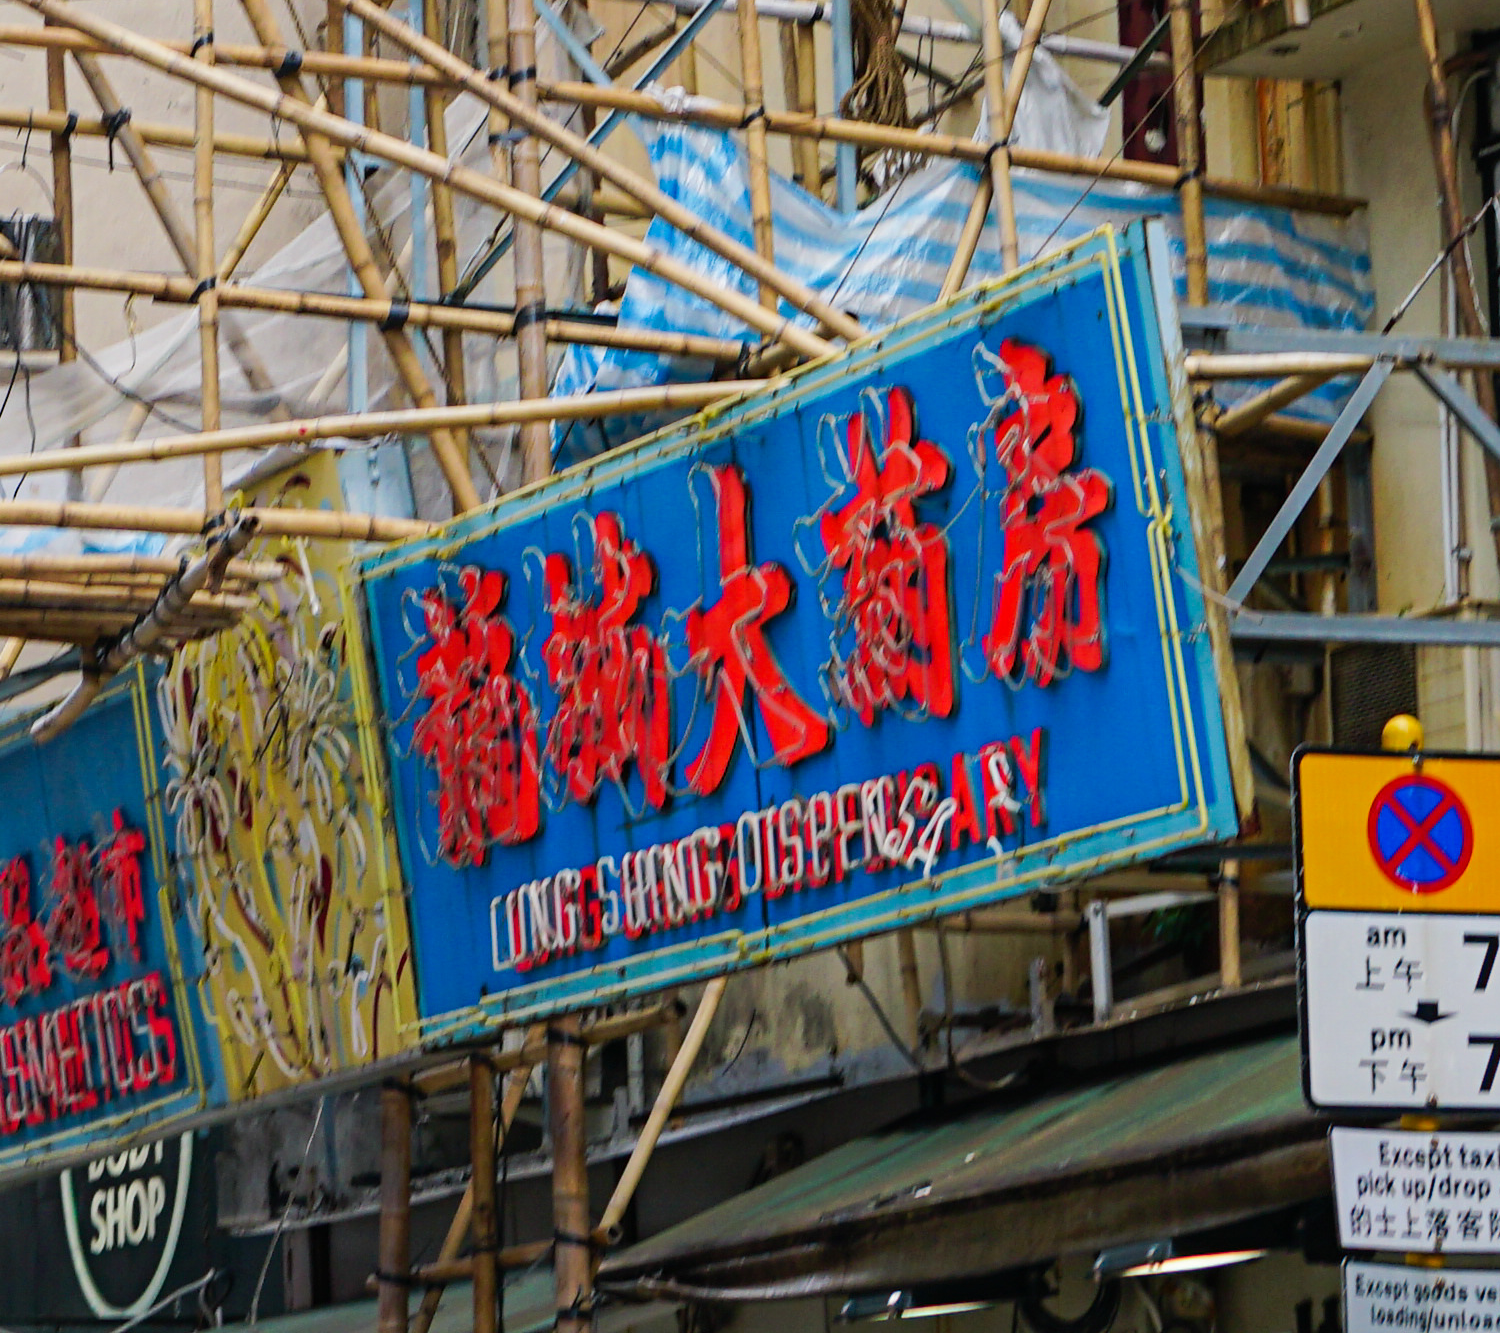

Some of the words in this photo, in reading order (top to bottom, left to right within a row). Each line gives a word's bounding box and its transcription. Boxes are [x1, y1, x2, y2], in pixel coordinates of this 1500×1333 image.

[1366, 923, 1406, 947] am
[1355, 957, 1423, 993] 上午
[1462, 935, 1500, 992] 7
[1370, 1028, 1411, 1054] pm
[1358, 1059, 1427, 1096] 下午
[1379, 1141, 1452, 1172] Except
[1357, 1170, 1395, 1199] pick
[1402, 1175, 1491, 1202] up/drop
[91, 1176, 166, 1254] SHOP
[1356, 1273, 1410, 1303] Except
[1414, 1280, 1468, 1306] goods
